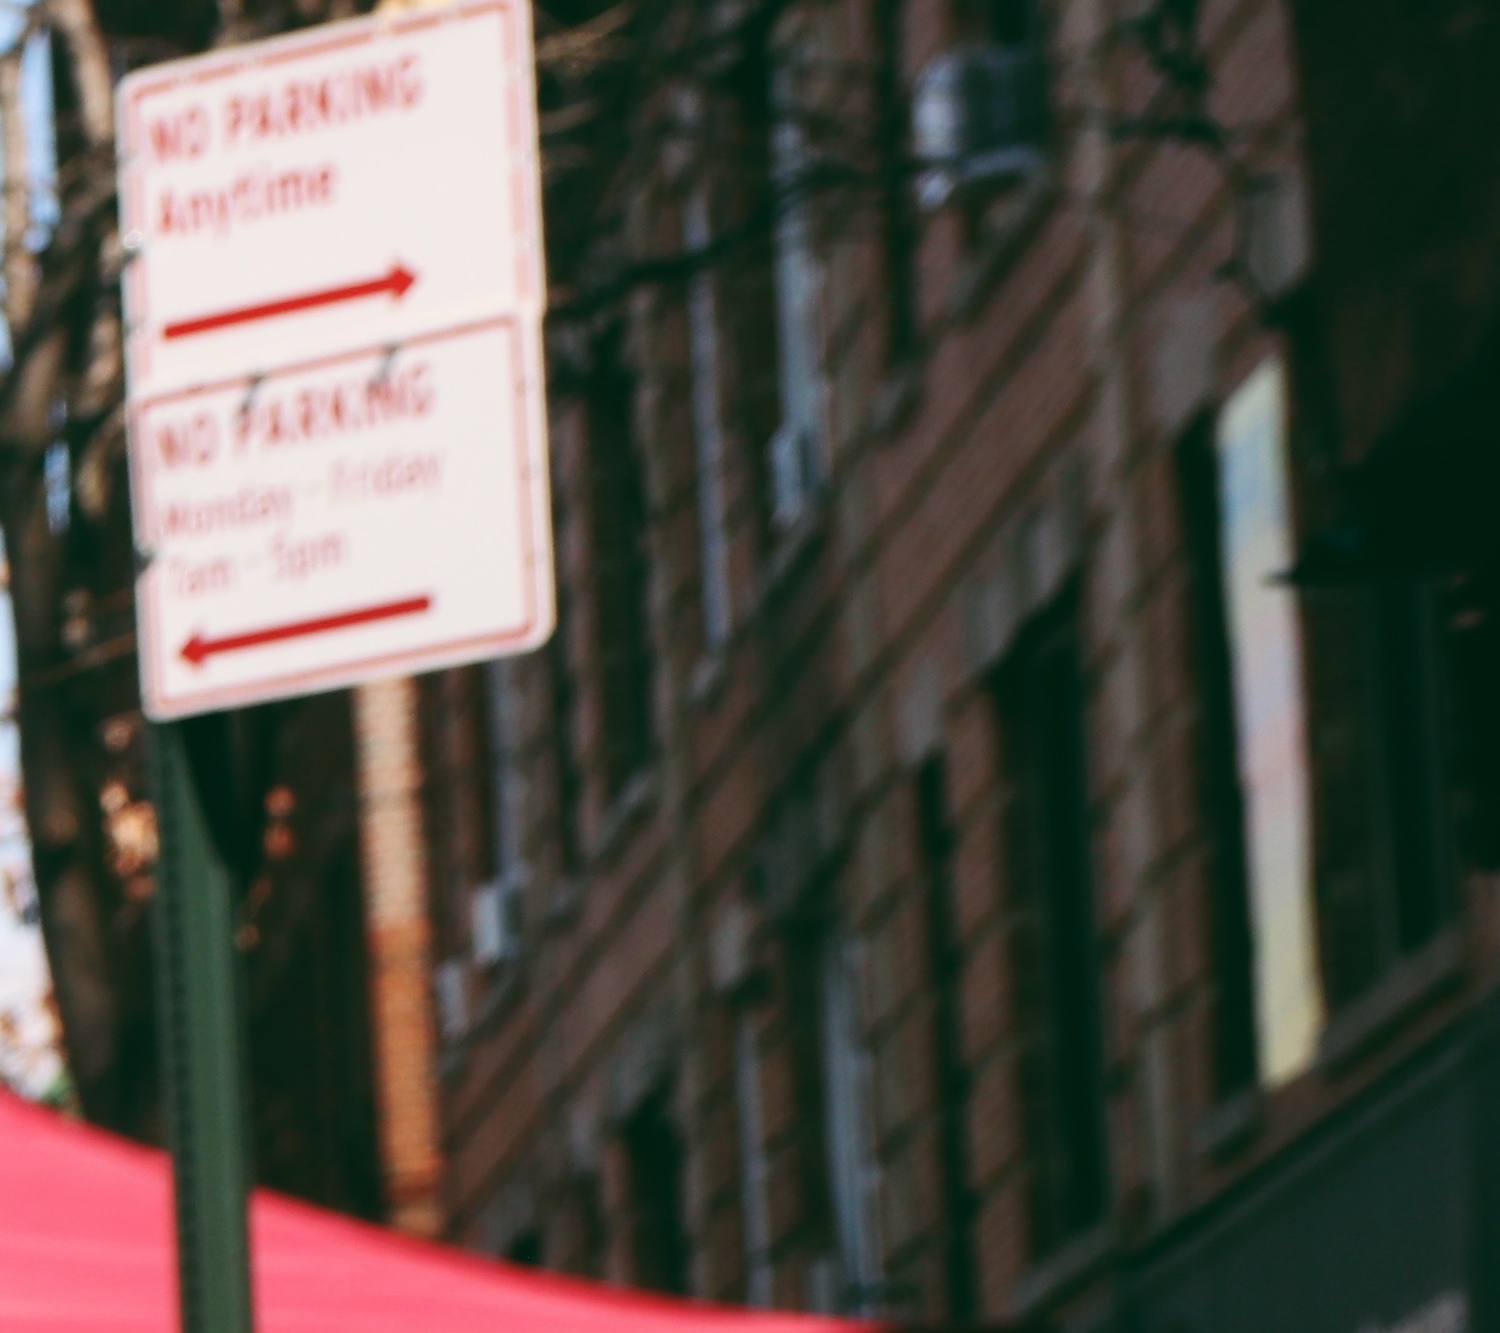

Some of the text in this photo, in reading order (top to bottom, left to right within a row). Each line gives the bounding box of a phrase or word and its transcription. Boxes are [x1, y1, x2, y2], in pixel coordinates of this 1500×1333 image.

[151, 55, 424, 161] NO PARKING
[158, 164, 337, 236] Anytime
[158, 361, 435, 469] NO PARKING
[165, 453, 440, 536] Monday Friday
